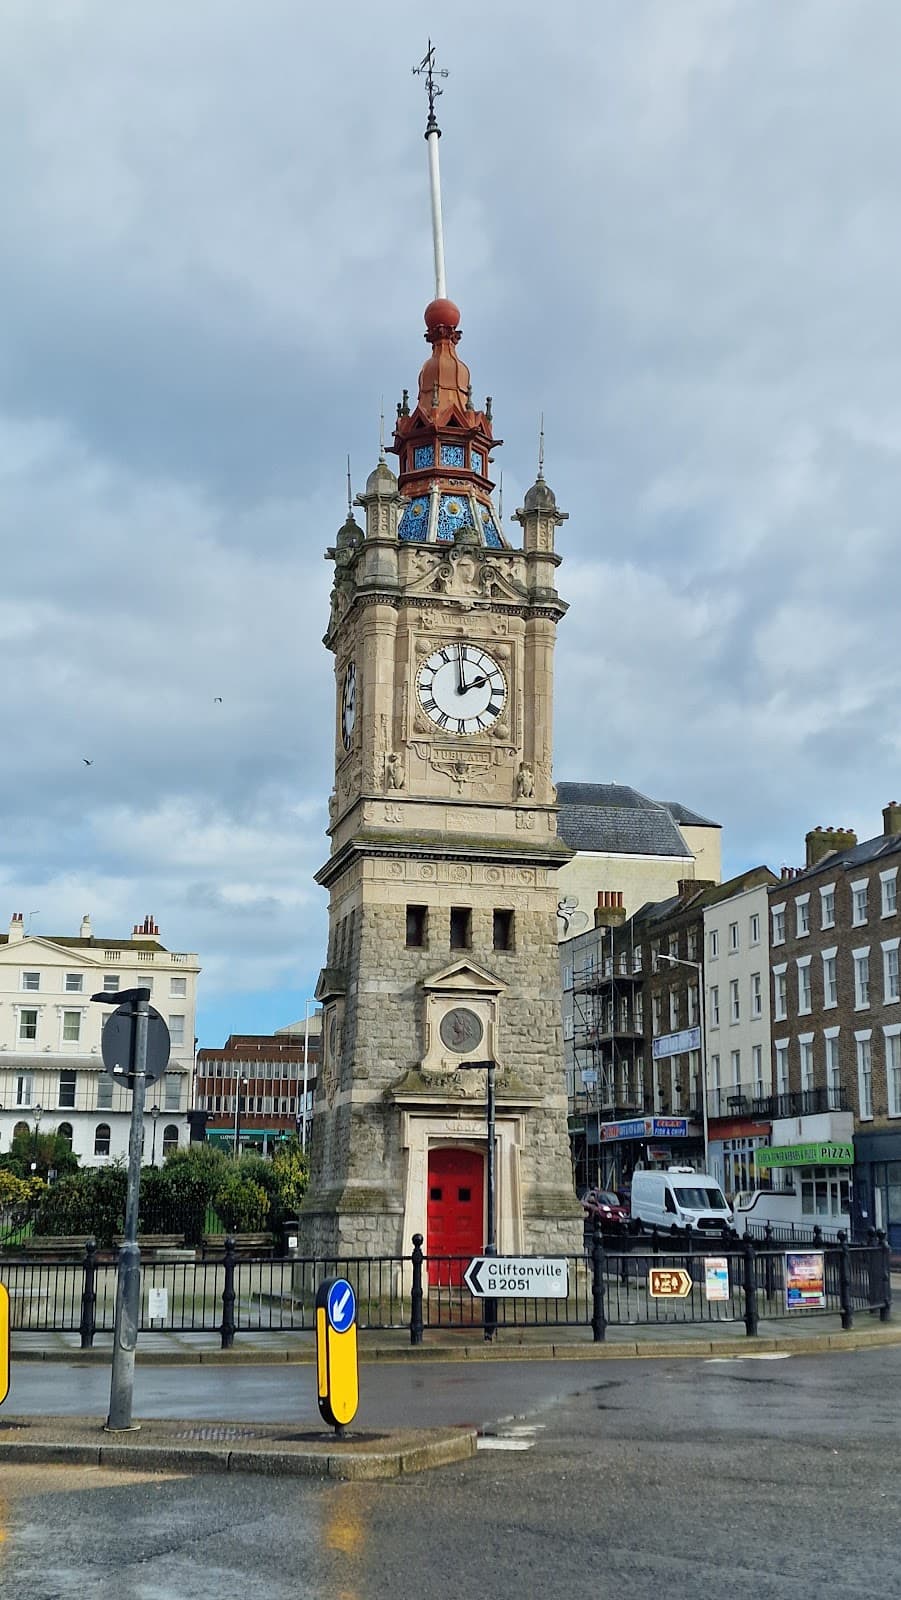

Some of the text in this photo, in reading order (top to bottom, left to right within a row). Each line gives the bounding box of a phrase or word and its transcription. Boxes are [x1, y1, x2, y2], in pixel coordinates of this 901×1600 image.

[434, 751, 489, 760] JUBILATE
[821, 1147, 851, 1159] PIZZA
[488, 1264, 562, 1276] Cliftonville
[488, 1279, 530, 1290] B 2051
